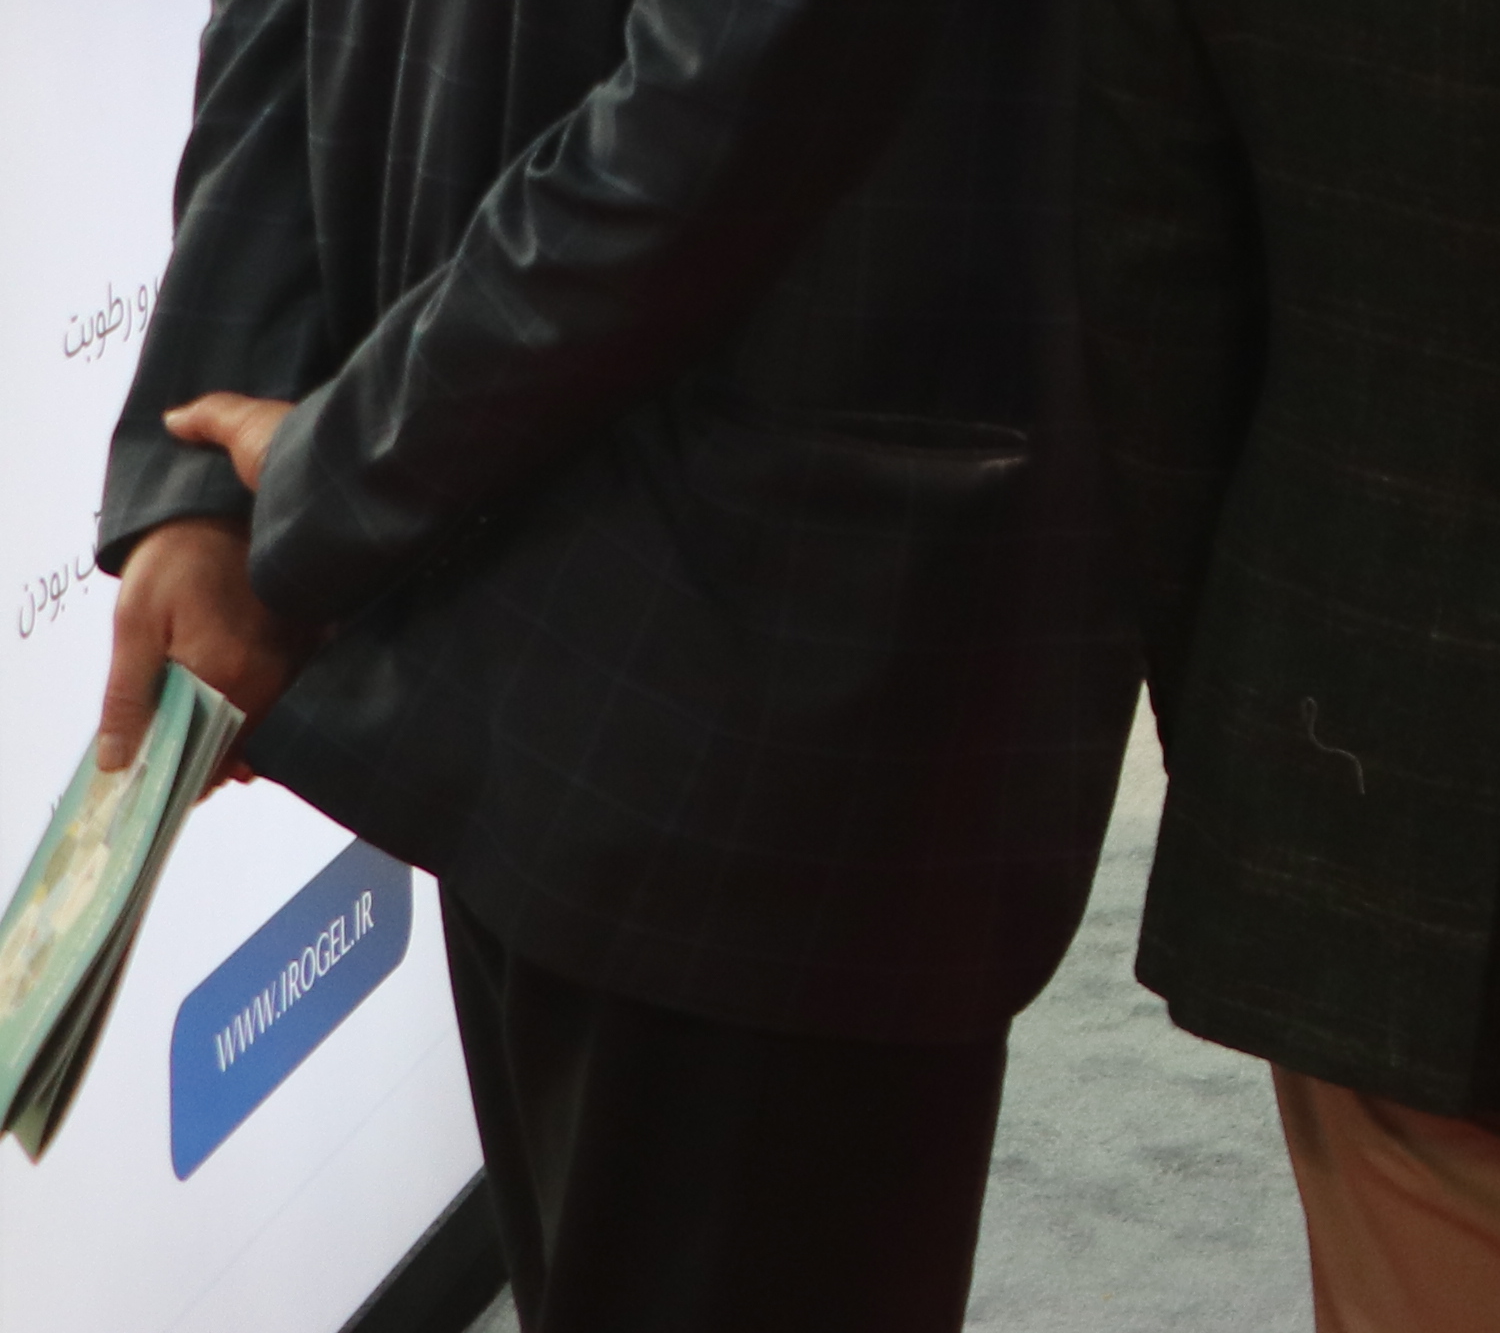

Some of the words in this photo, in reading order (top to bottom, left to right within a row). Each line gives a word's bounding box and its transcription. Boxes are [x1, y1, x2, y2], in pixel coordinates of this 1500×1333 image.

[64, 281, 132, 362] رطوبت
[18, 563, 69, 640] بودن
[213, 890, 376, 1074] WWW.IROGEL.IR
